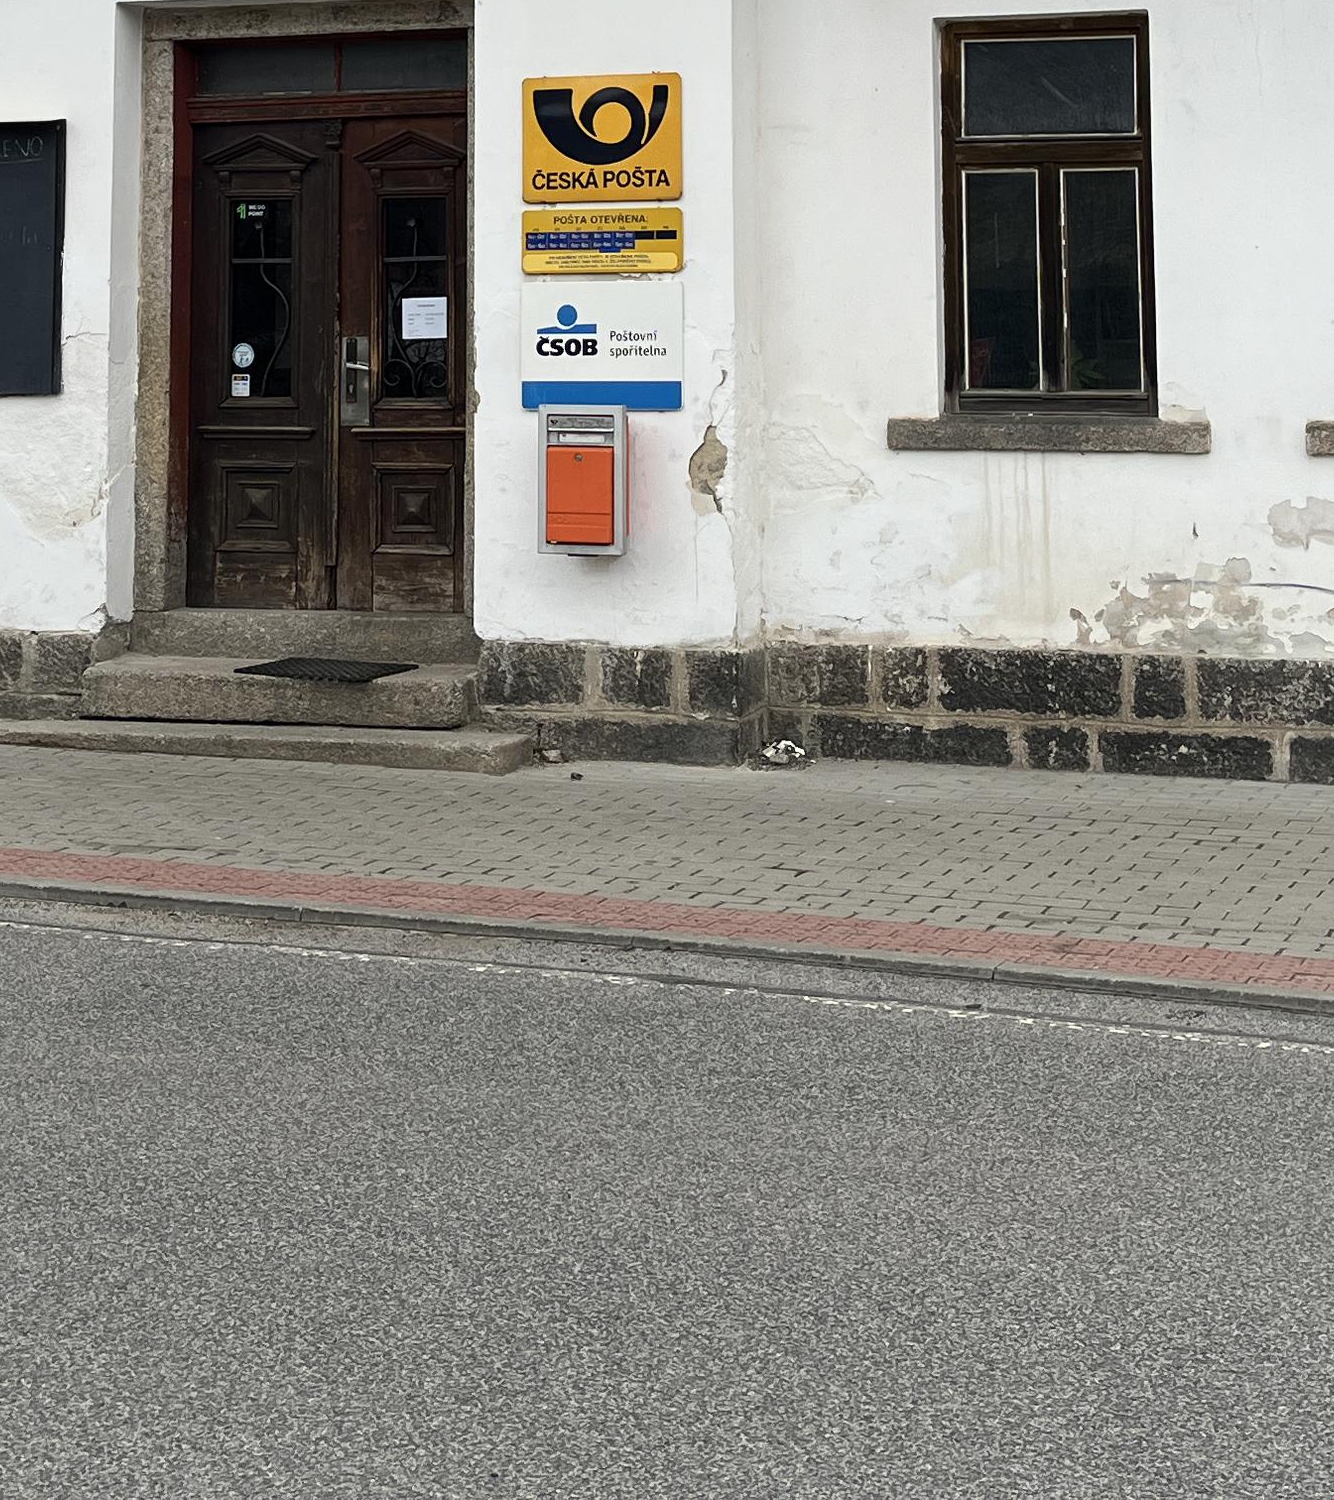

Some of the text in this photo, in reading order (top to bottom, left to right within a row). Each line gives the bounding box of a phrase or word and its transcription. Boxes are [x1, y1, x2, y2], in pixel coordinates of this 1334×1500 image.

[532, 166, 670, 190] ČESKÁ POŠTA
[553, 214, 587, 225] POŠTA
[609, 330, 658, 342] Poštovní
[536, 336, 598, 356] ČSOB
[609, 345, 667, 358] spořitelna
